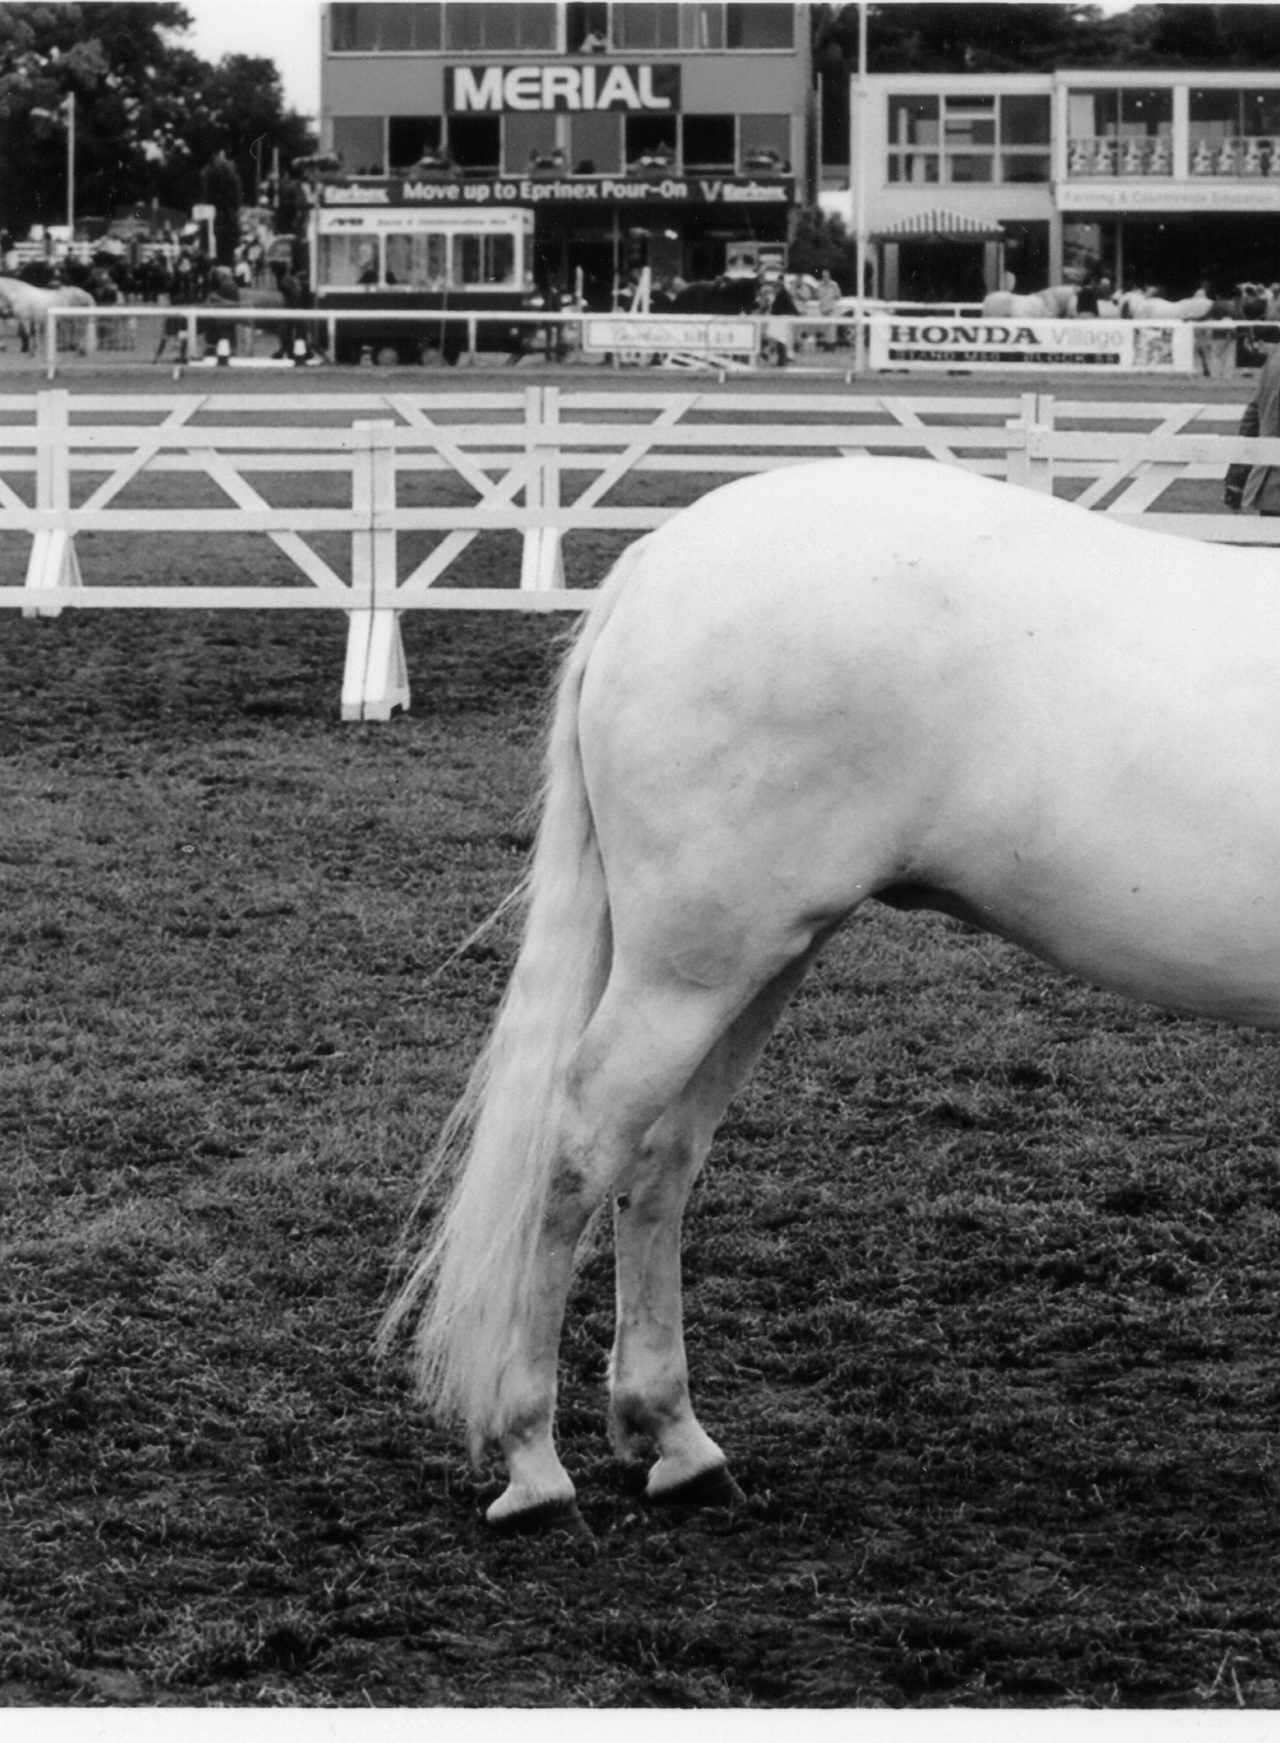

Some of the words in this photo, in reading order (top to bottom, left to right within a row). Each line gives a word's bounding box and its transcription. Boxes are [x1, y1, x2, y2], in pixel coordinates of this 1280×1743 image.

[454, 65, 671, 111] MERIAL
[403, 182, 459, 199] Move
[463, 185, 490, 202] up
[494, 182, 516, 199] to
[520, 181, 597, 202] Eprinex
[601, 179, 688, 199] Pour-On
[889, 324, 1041, 344] HONDA
